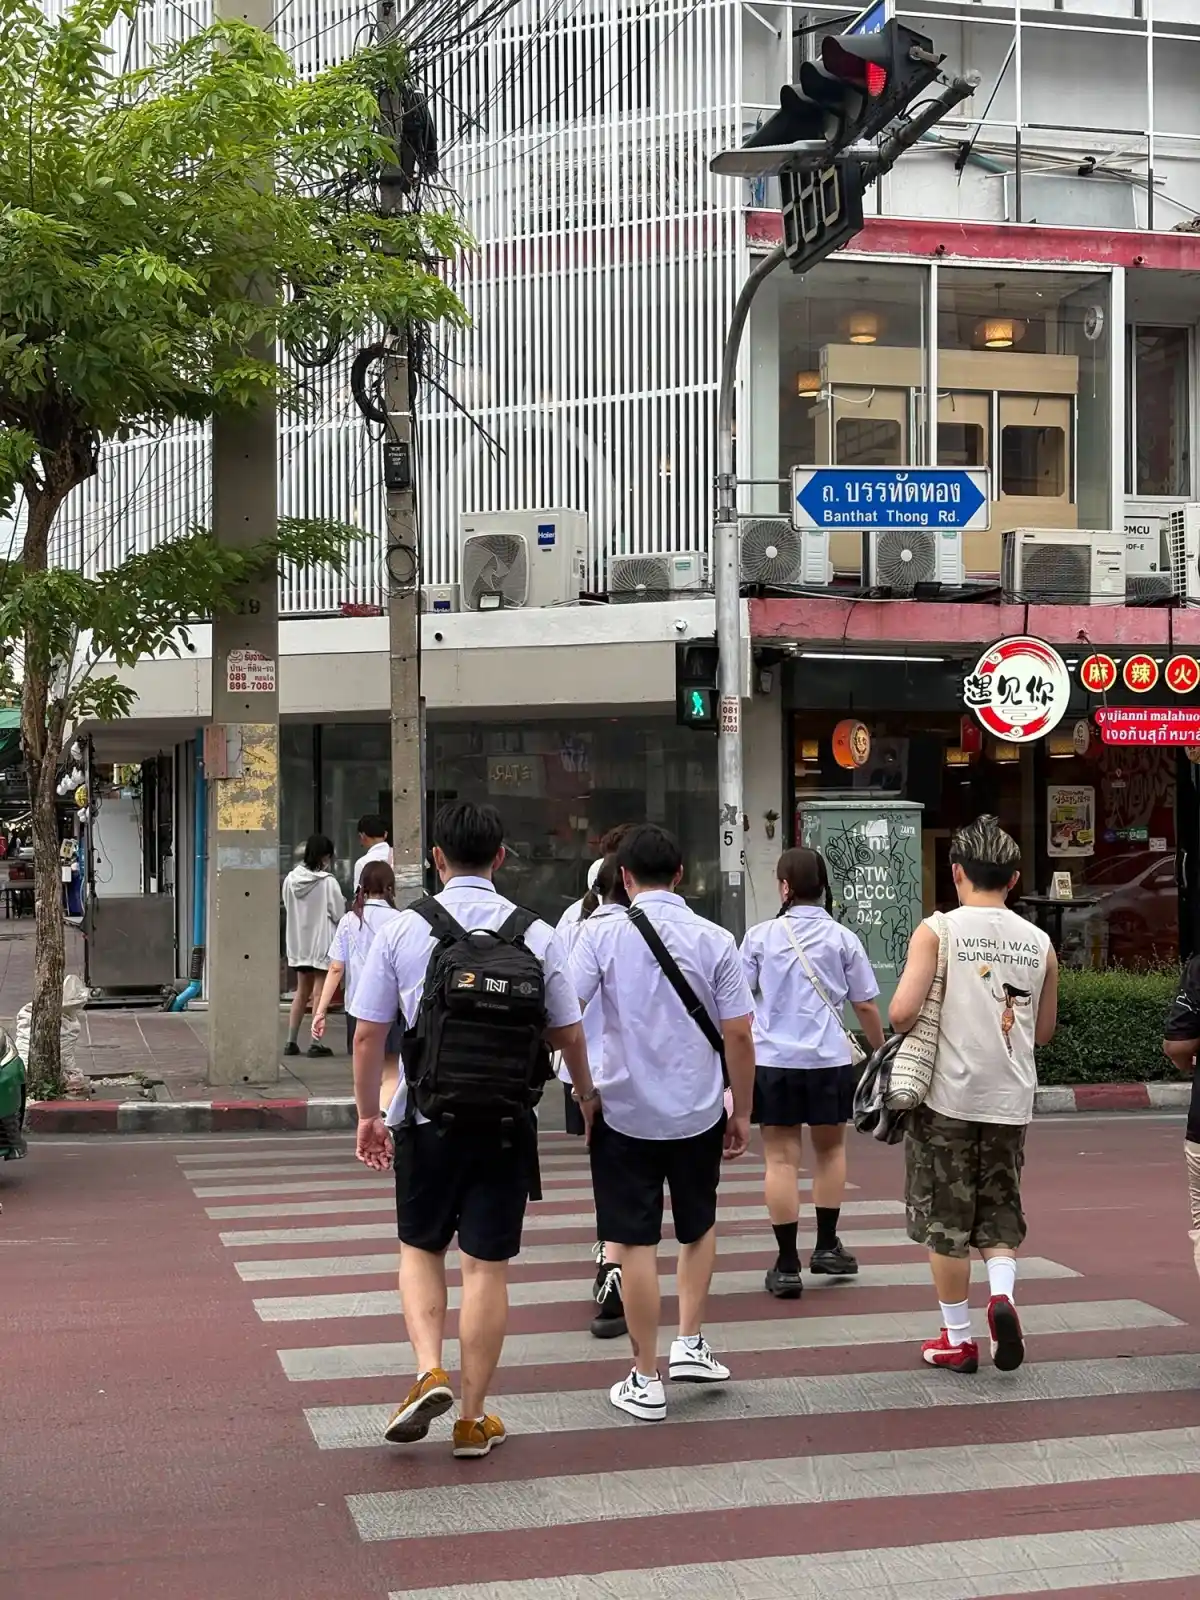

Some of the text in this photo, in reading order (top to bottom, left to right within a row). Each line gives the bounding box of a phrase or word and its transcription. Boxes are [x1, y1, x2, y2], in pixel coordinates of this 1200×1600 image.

[822, 473, 961, 503] ถ. บรรทัดทอง
[823, 509, 960, 525] Banthat Thong Rd.
[229, 672, 247, 681] 089
[229, 682, 274, 691] 896-7080
[966, 674, 1054, 706] 遇见你
[722, 706, 738, 714] 081
[1098, 710, 1148, 723] yujianni
[723, 830, 734, 847] 5
[855, 866, 890, 882] PTW
[843, 884, 896, 901] OFCCC
[857, 910, 882, 925] 042
[956, 938, 1039, 955] I WISH, I WAS
[957, 951, 1040, 969] SUNBATHING
